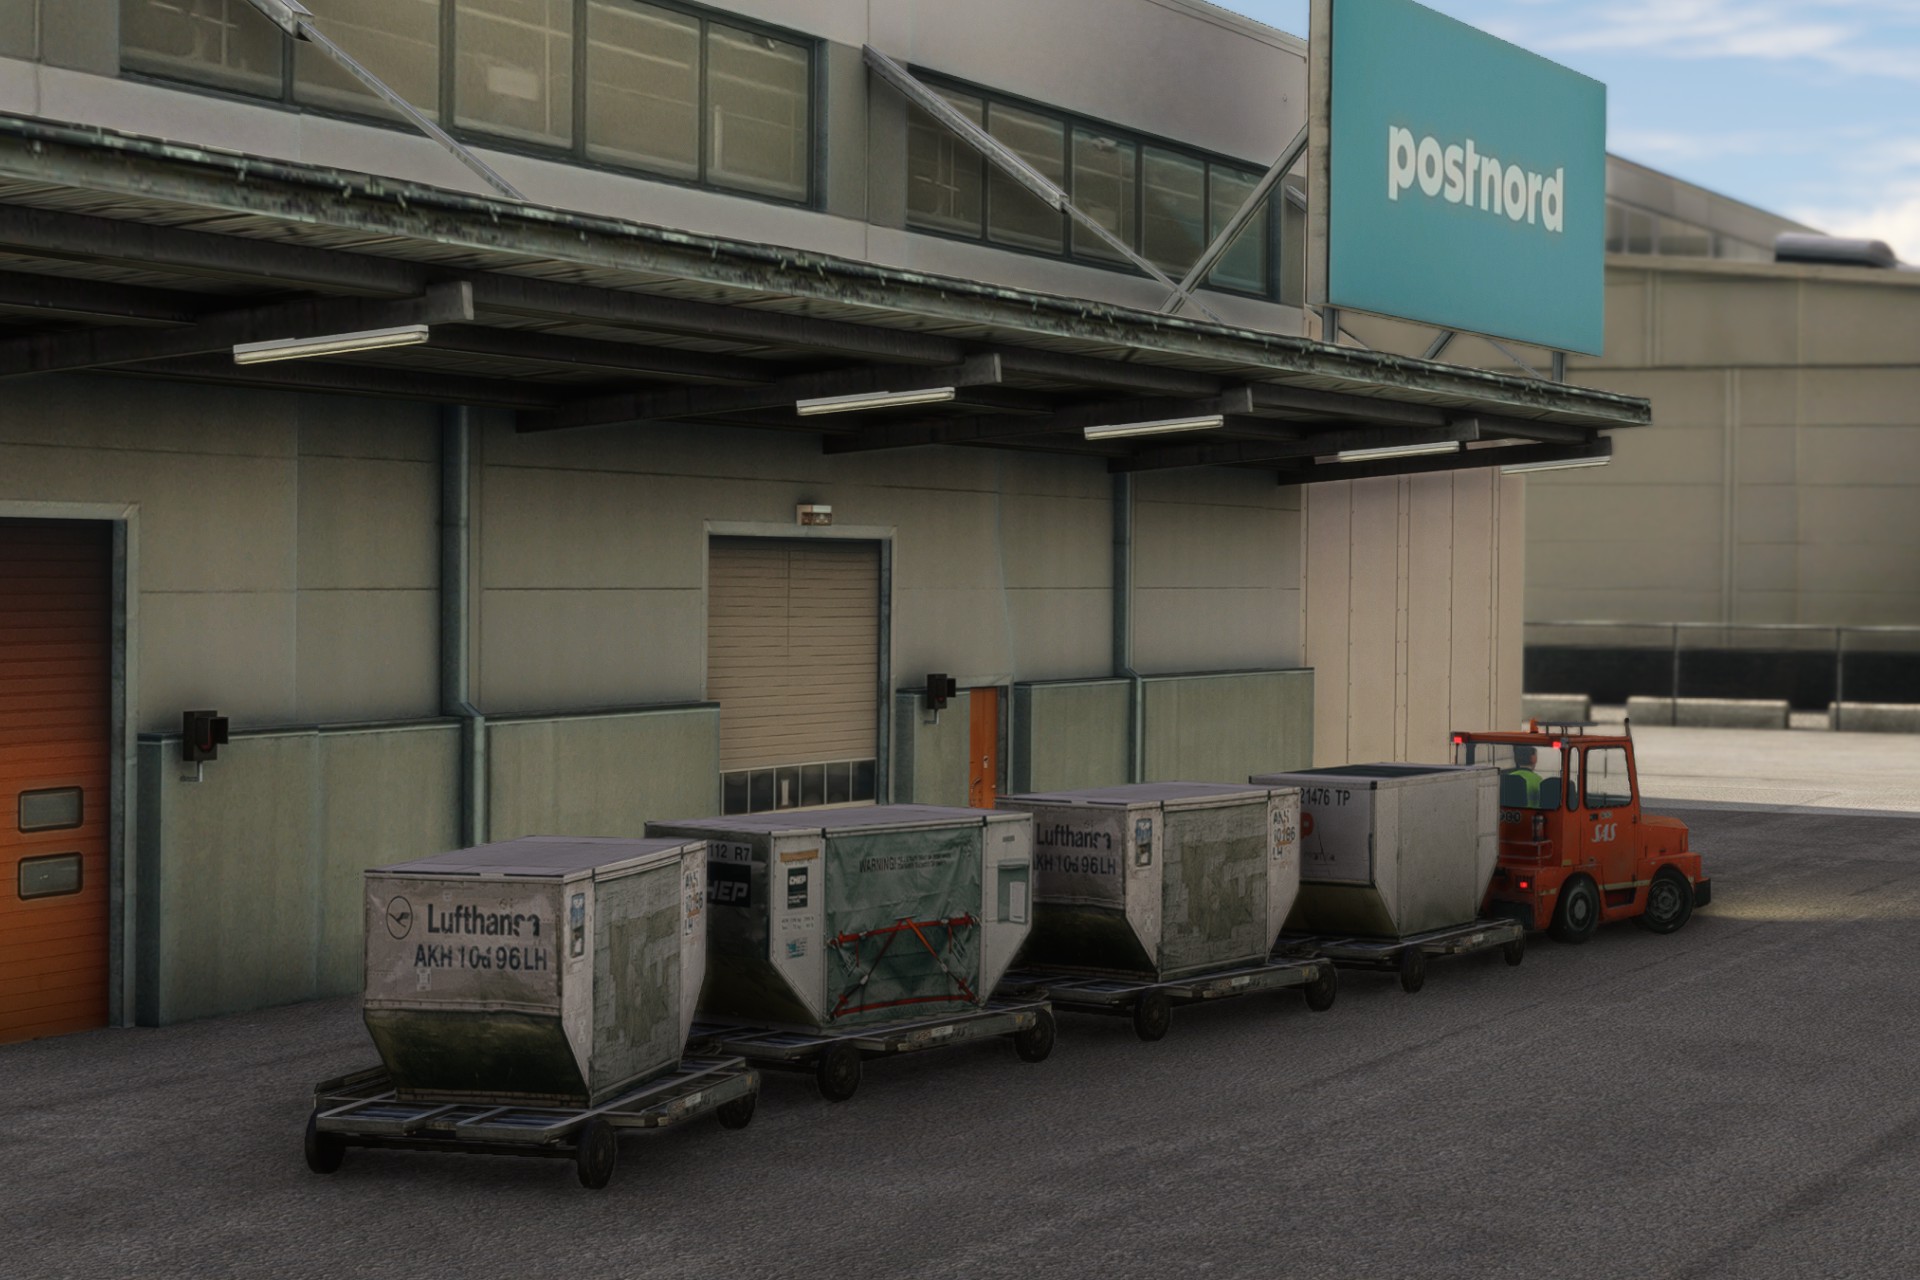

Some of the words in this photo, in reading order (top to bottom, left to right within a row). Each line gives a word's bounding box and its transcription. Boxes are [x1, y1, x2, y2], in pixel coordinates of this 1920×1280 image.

[1387, 125, 1564, 233] postnord
[1335, 789, 1350, 806] TP
[1591, 822, 1618, 843] SAS
[735, 846, 750, 862] R7
[414, 944, 453, 969] AKH
